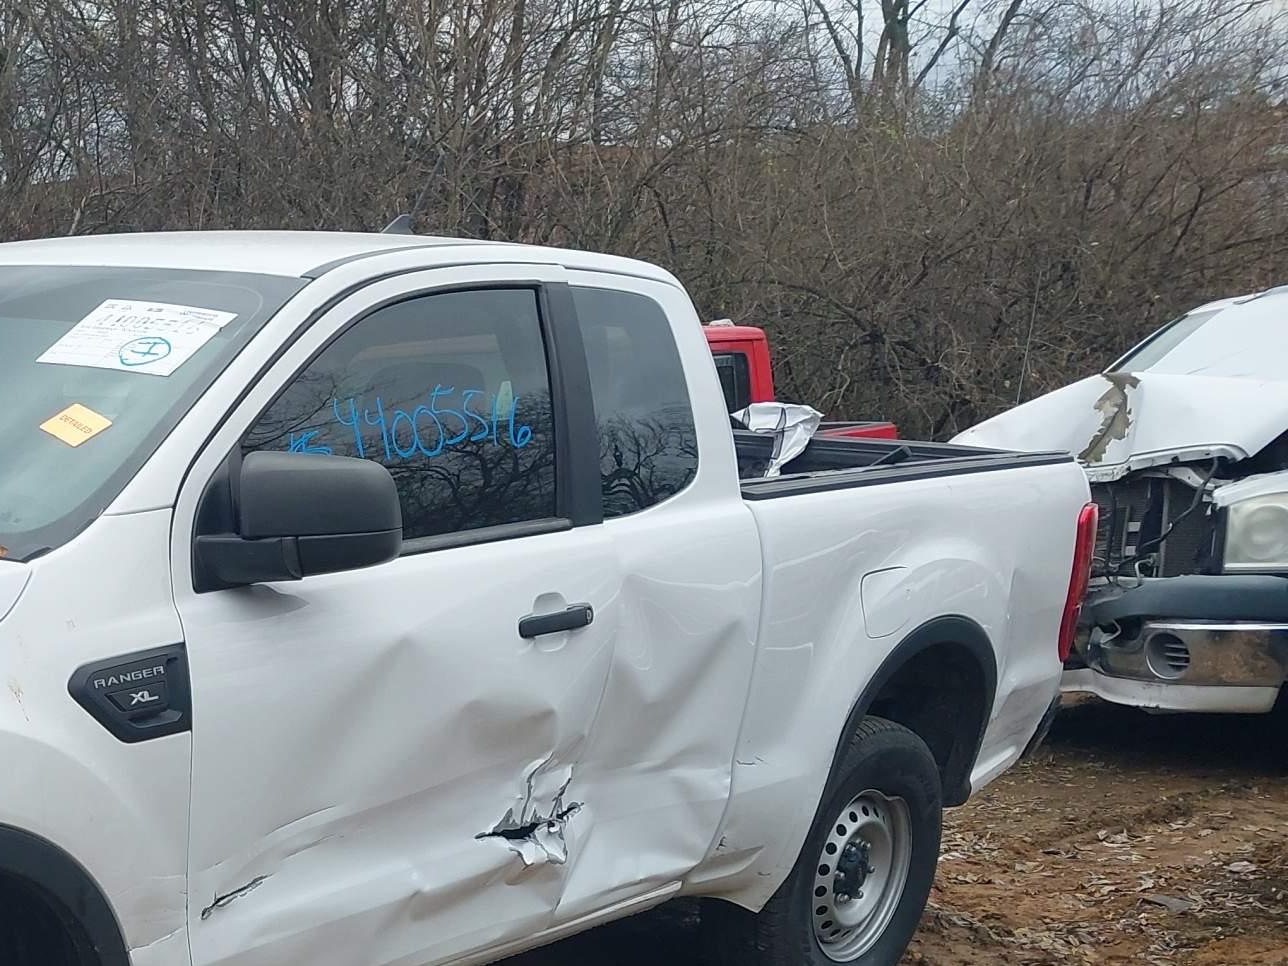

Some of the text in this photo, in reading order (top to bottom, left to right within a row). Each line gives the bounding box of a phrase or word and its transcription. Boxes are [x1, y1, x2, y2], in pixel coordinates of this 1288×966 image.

[333, 384, 532, 460] 44005516
[93, 665, 165, 688] RANGER
[129, 690, 160, 705] XL
